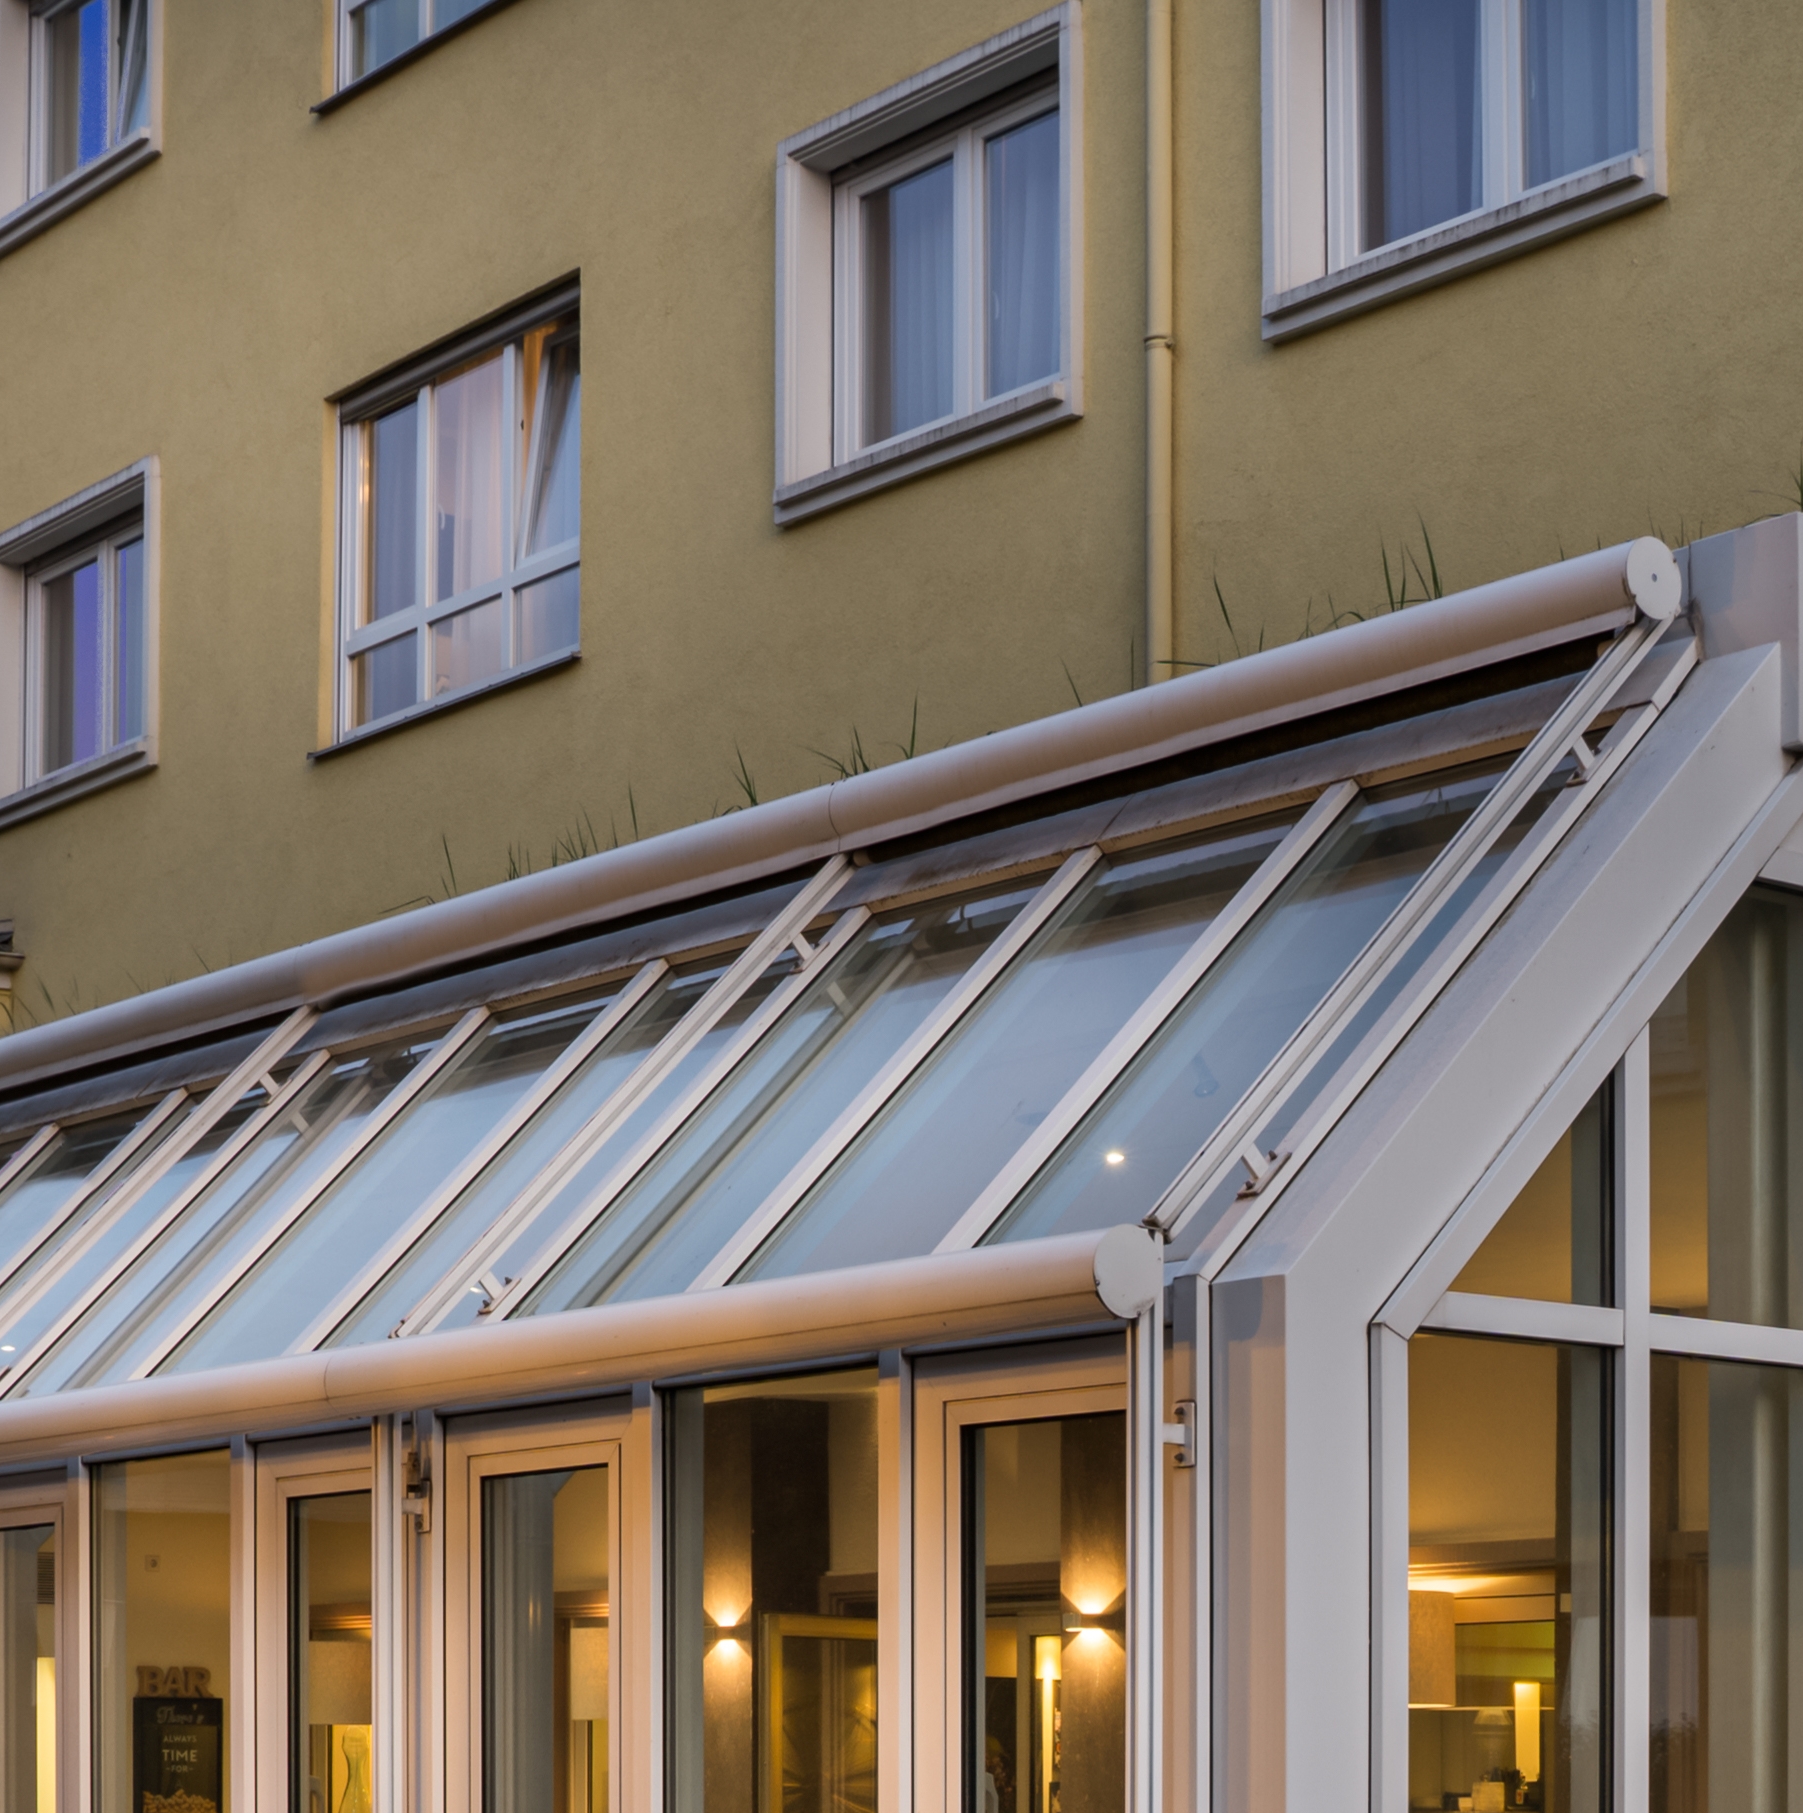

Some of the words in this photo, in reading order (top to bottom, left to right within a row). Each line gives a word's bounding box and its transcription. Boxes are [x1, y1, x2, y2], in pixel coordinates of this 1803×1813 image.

[136, 1665, 213, 1698] BAR
[163, 1735, 197, 1743] ALWAYS
[162, 1749, 198, 1762] TIME
